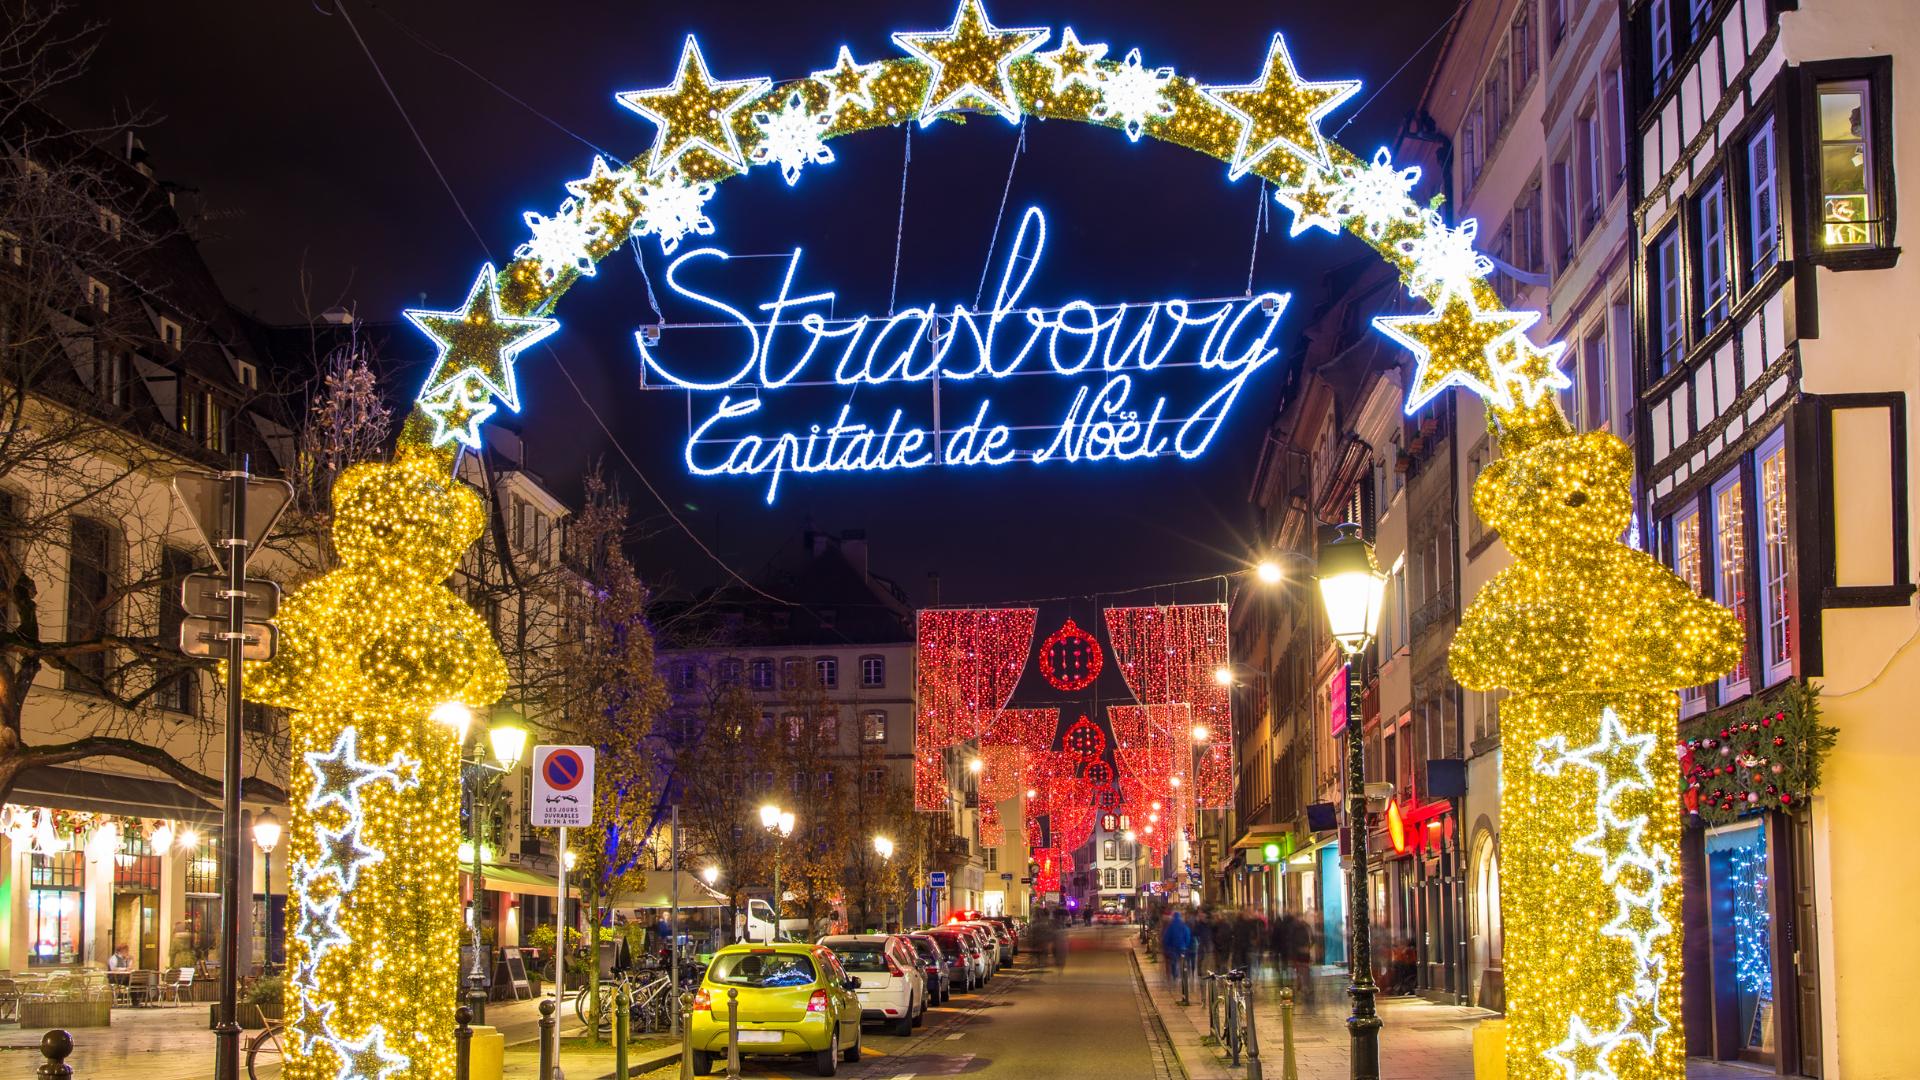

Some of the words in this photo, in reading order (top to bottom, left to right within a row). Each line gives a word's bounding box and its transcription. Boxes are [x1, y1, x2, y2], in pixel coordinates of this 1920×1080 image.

[634, 206, 1292, 460] Strasbourg
[685, 395, 933, 505] Capitale
[945, 399, 1016, 466] de
[1031, 374, 1168, 464] Noël
